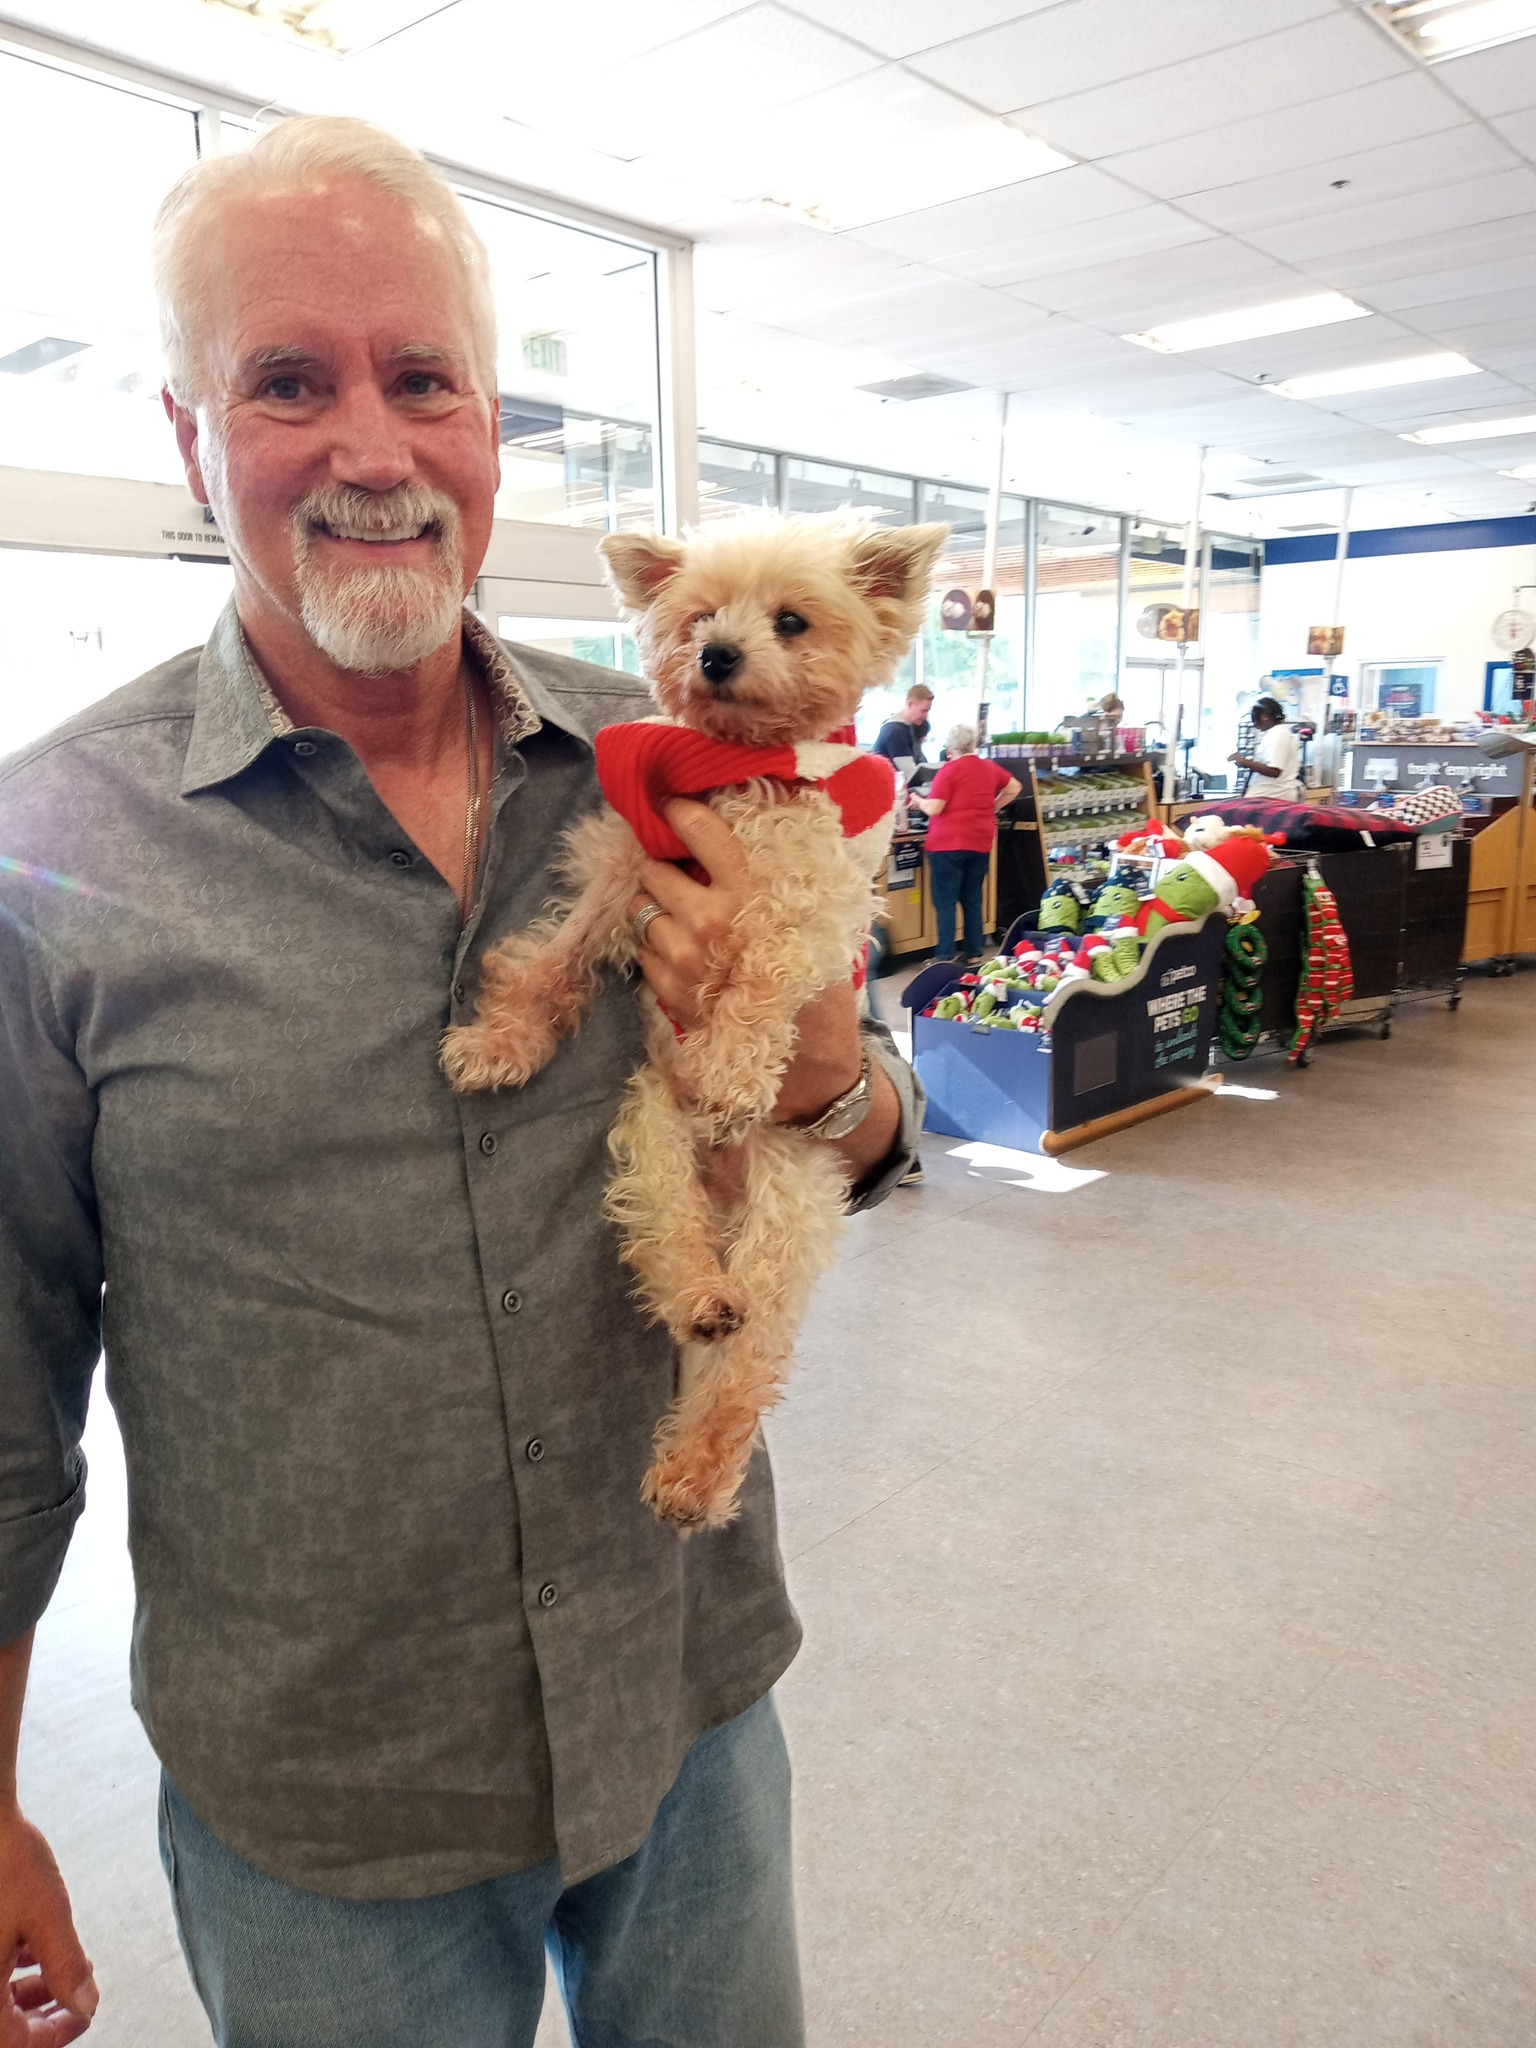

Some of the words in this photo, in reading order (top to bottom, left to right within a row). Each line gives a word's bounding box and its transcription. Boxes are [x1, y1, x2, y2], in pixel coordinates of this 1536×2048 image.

[530, 338, 562, 371] EXIT
[162, 530, 175, 540] THIS
[177, 532, 193, 542] DOOR
[195, 533, 203, 542] TO
[1146, 991, 1187, 1017] WHERE
[1185, 984, 1208, 1005] THE
[1154, 1010, 1182, 1034] PETS
[1182, 1005, 1200, 1024] GO
